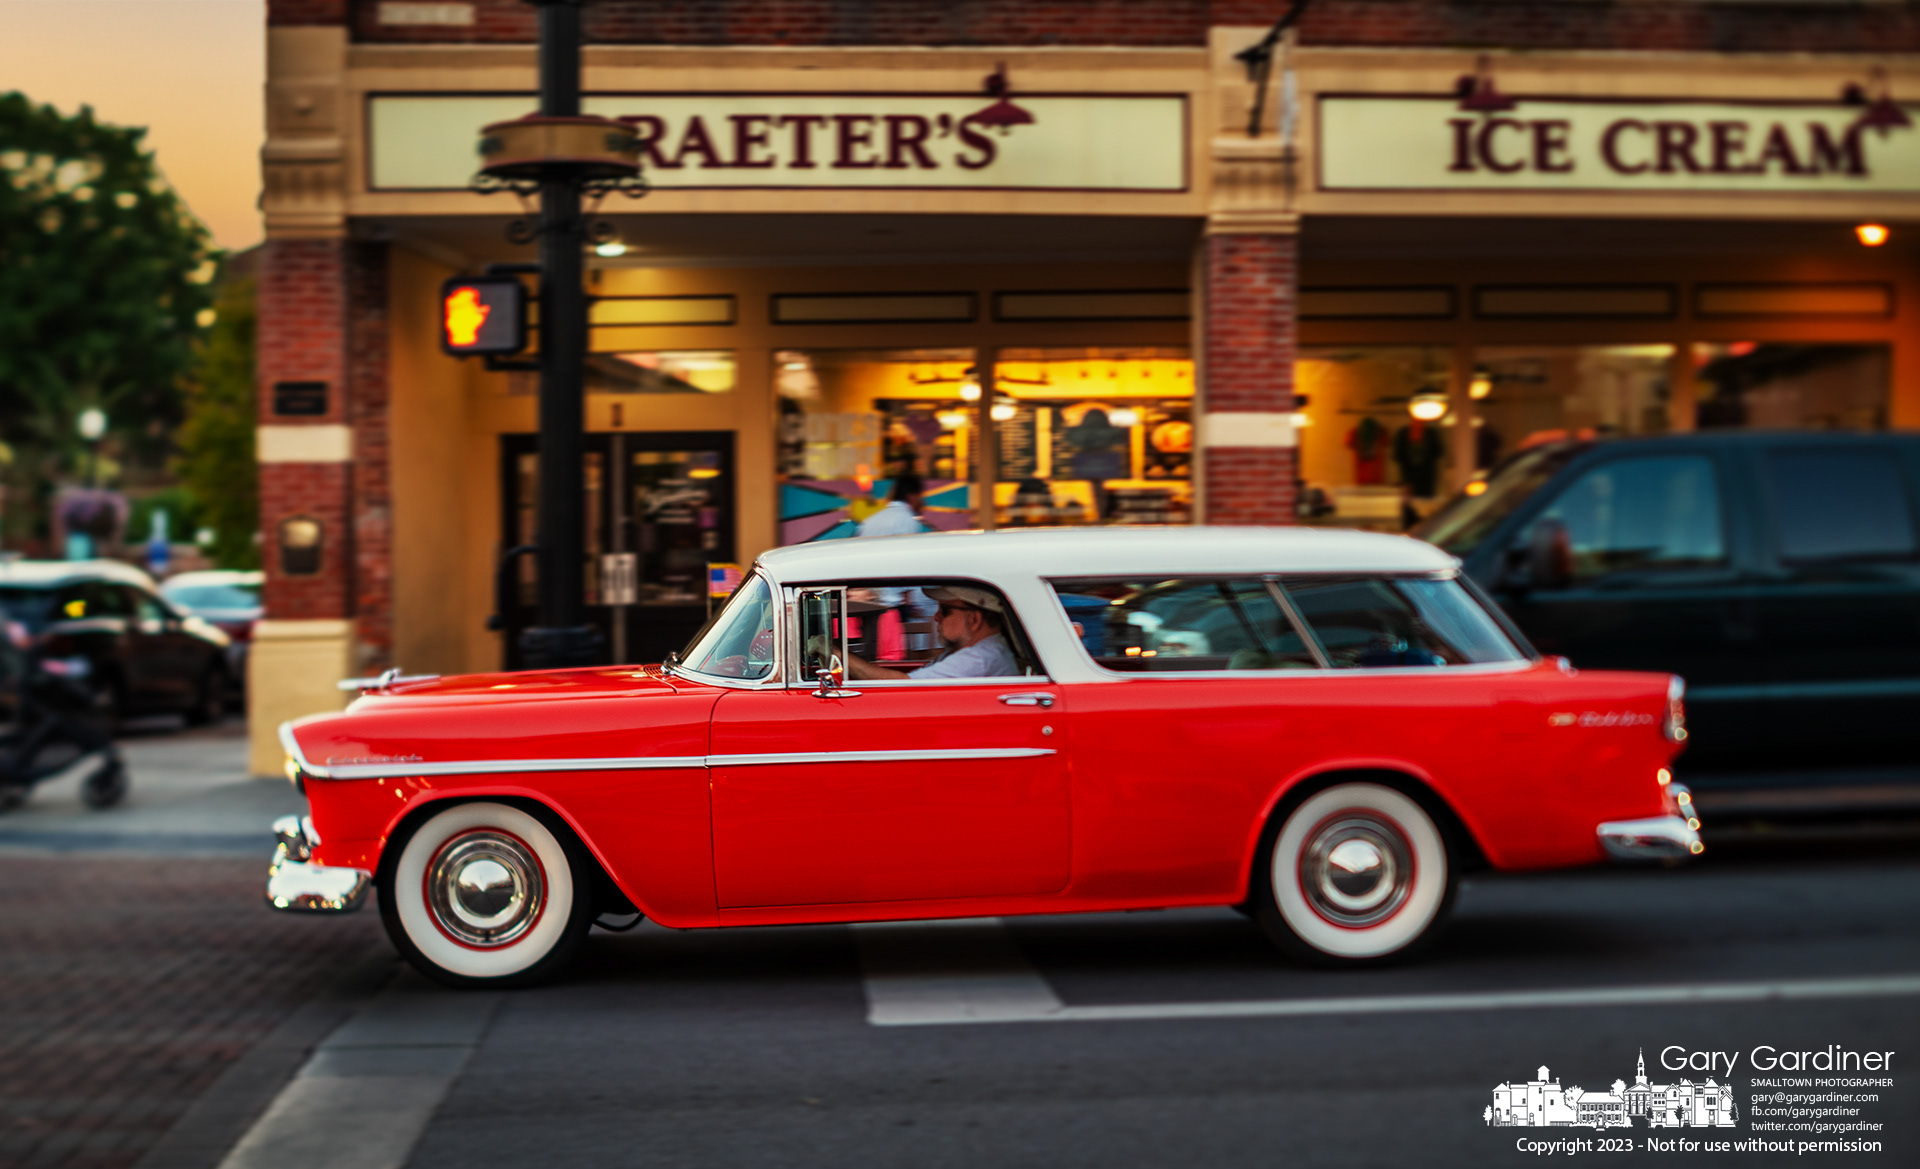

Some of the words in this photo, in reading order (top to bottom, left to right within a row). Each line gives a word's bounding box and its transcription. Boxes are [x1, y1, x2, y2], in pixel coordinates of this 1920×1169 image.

[618, 113, 998, 171] RAETER'S
[1448, 117, 1573, 174] ICE
[1600, 119, 1869, 177] CREAM
